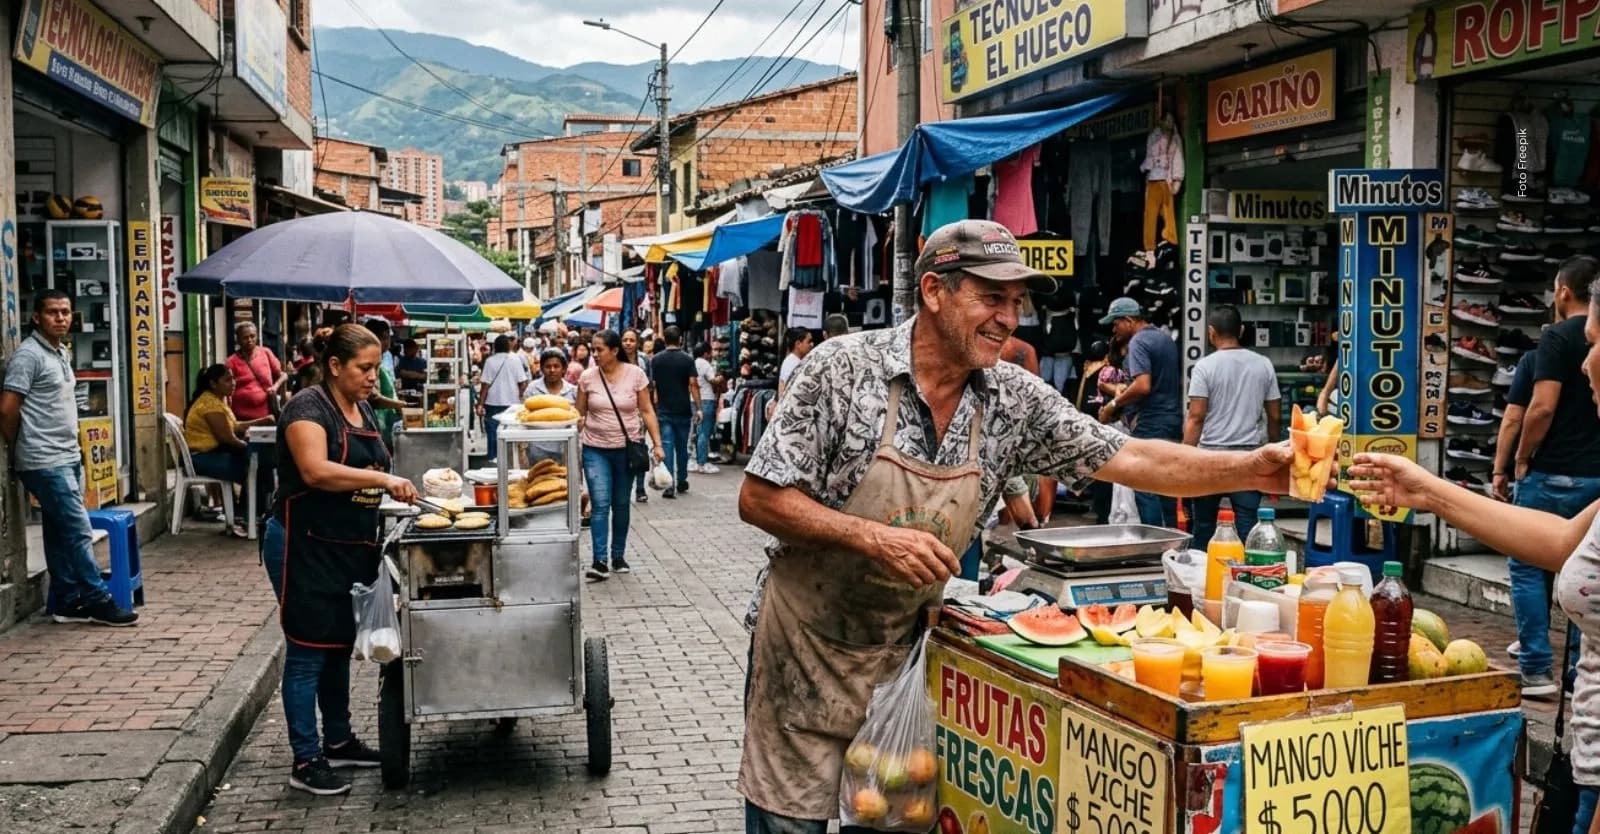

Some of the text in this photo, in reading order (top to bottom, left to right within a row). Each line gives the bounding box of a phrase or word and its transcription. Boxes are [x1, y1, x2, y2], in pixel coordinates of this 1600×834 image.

[969, 0, 1063, 45] TECNOL
[986, 3, 1092, 81] EL HUECO
[1452, 0, 1600, 67] ROFP
[1235, 193, 1325, 220] Minutos
[1338, 175, 1442, 205] Minutos
[1187, 230, 1202, 410] TECNOLO
[1341, 218, 1355, 430] MINUTOS
[1368, 216, 1407, 431] MINUTOS
[941, 664, 1046, 765] FRUTAS
[935, 724, 1055, 834] FRESCAS
[1067, 717, 1157, 789] MANGO
[1250, 731, 1337, 790] MANGO
[1086, 764, 1154, 827] VICHE
